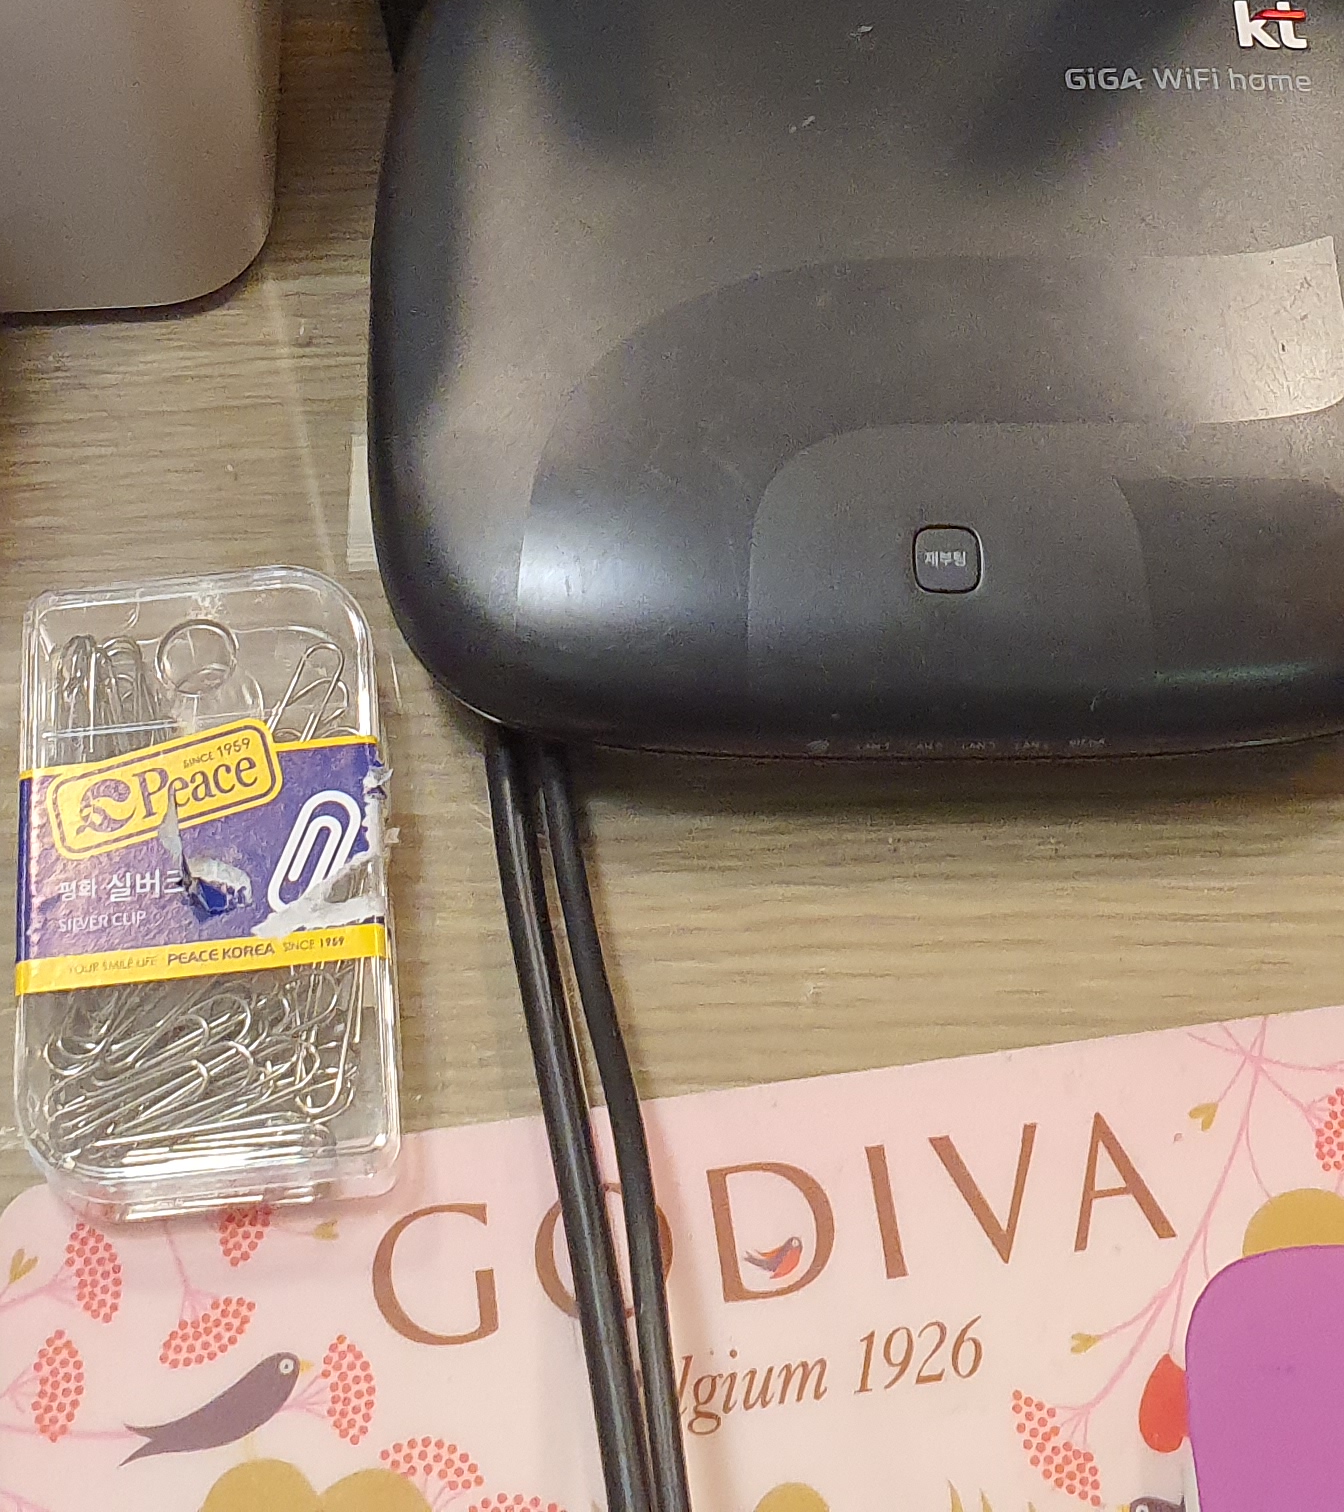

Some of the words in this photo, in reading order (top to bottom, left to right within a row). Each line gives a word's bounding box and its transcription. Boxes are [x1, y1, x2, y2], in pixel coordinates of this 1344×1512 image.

[1233, 0, 1308, 50] kt
[1064, 67, 1144, 90] GiGA
[1152, 67, 1220, 90] WiFi
[1228, 67, 1312, 92] home
[923, 550, 967, 569] 재부팅
[183, 751, 215, 769] SINCE
[217, 737, 252, 758] 1959
[132, 756, 258, 820] Peace
[58, 913, 109, 934] SILVER
[111, 910, 147, 927] CLIP
[167, 949, 219, 967] PEACE
[222, 942, 276, 960] KOREA
[677, 1350, 828, 1437] lgium
[854, 1315, 984, 1396] 1926
